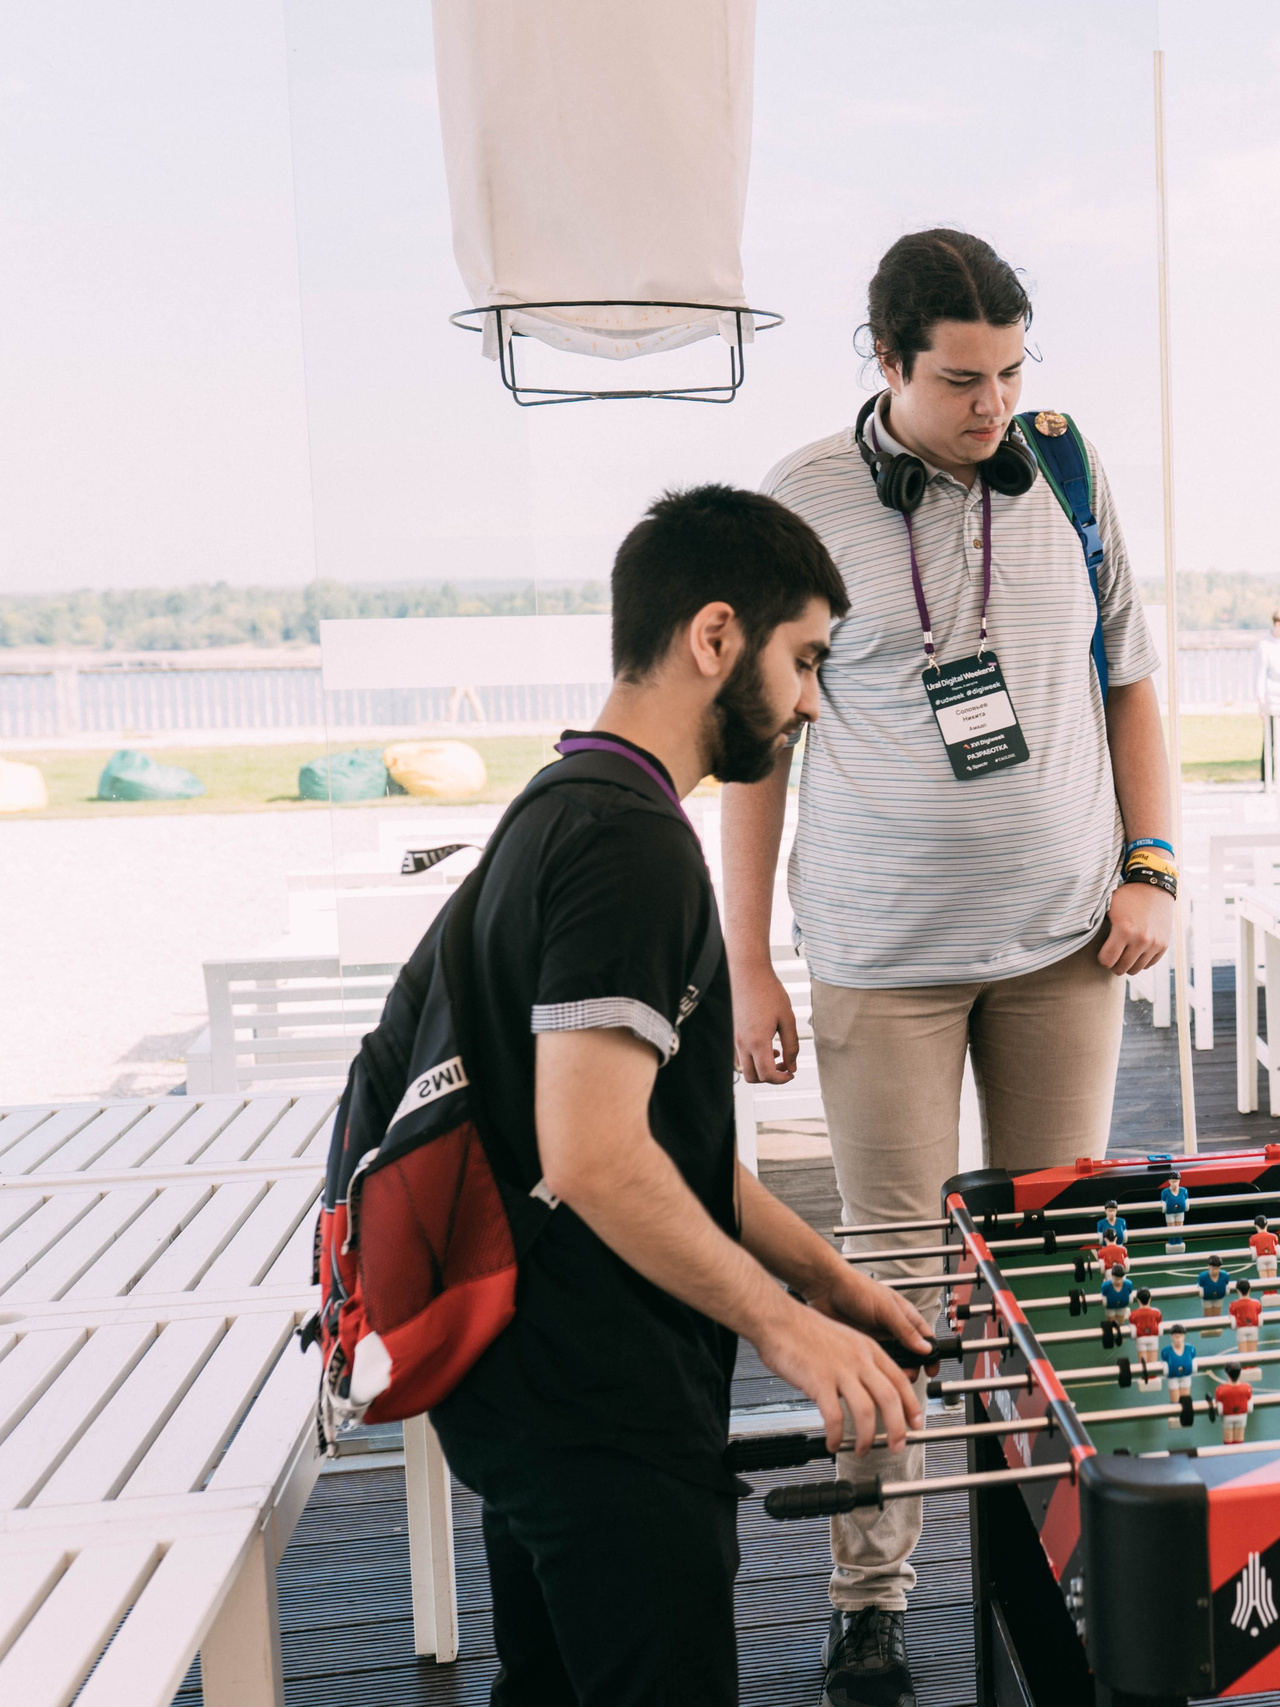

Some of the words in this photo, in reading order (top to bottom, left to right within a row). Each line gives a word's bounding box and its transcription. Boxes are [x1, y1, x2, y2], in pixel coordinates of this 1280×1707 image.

[926, 682, 941, 690] Ural
[941, 675, 963, 686] Digital
[963, 666, 995, 679] Weekend
[935, 693, 965, 705] #udweek
[967, 682, 1001, 695] #digiweek
[955, 702, 988, 715] Соловьев
[962, 712, 986, 722] Никита
[979, 734, 1005, 745] Digiweek
[967, 744, 1008, 760] РАЗРАБОТКА
